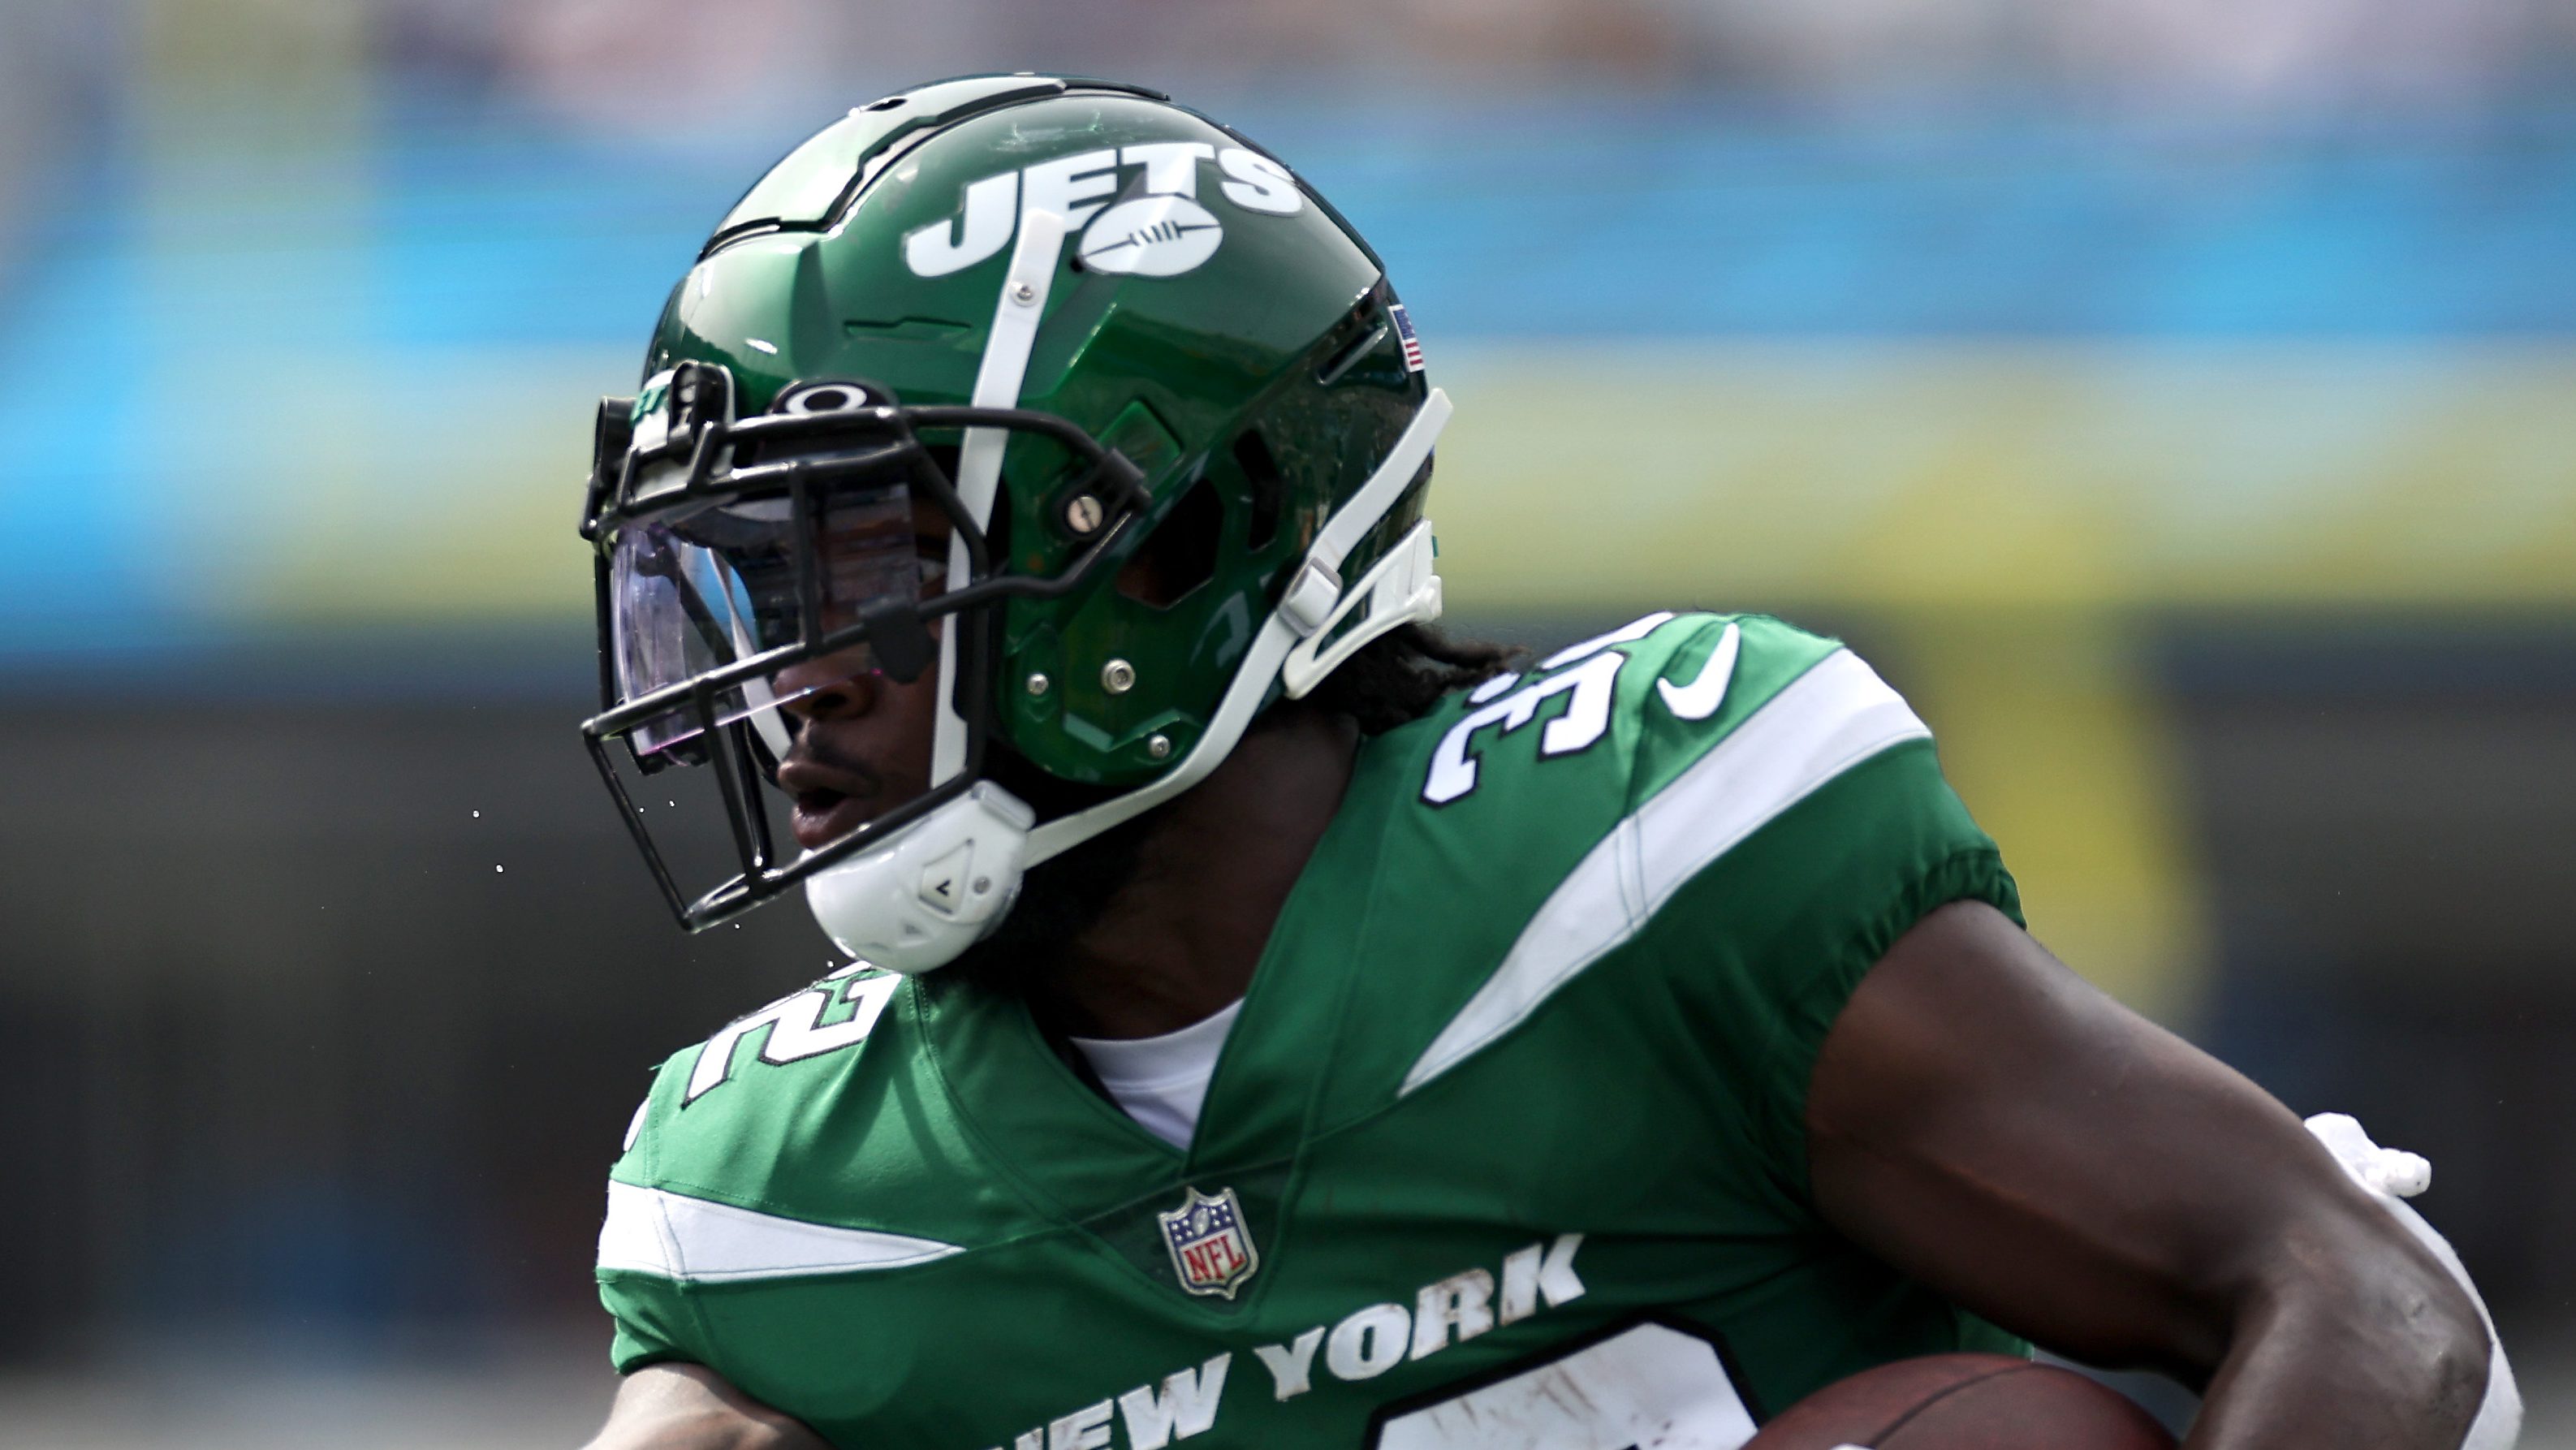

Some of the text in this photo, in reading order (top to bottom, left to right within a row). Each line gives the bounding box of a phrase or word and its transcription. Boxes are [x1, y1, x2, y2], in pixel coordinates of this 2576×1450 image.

[905, 141, 1303, 278] JETS
[1183, 1234, 1247, 1282] NFL
[1254, 1233, 1587, 1403] YORK
